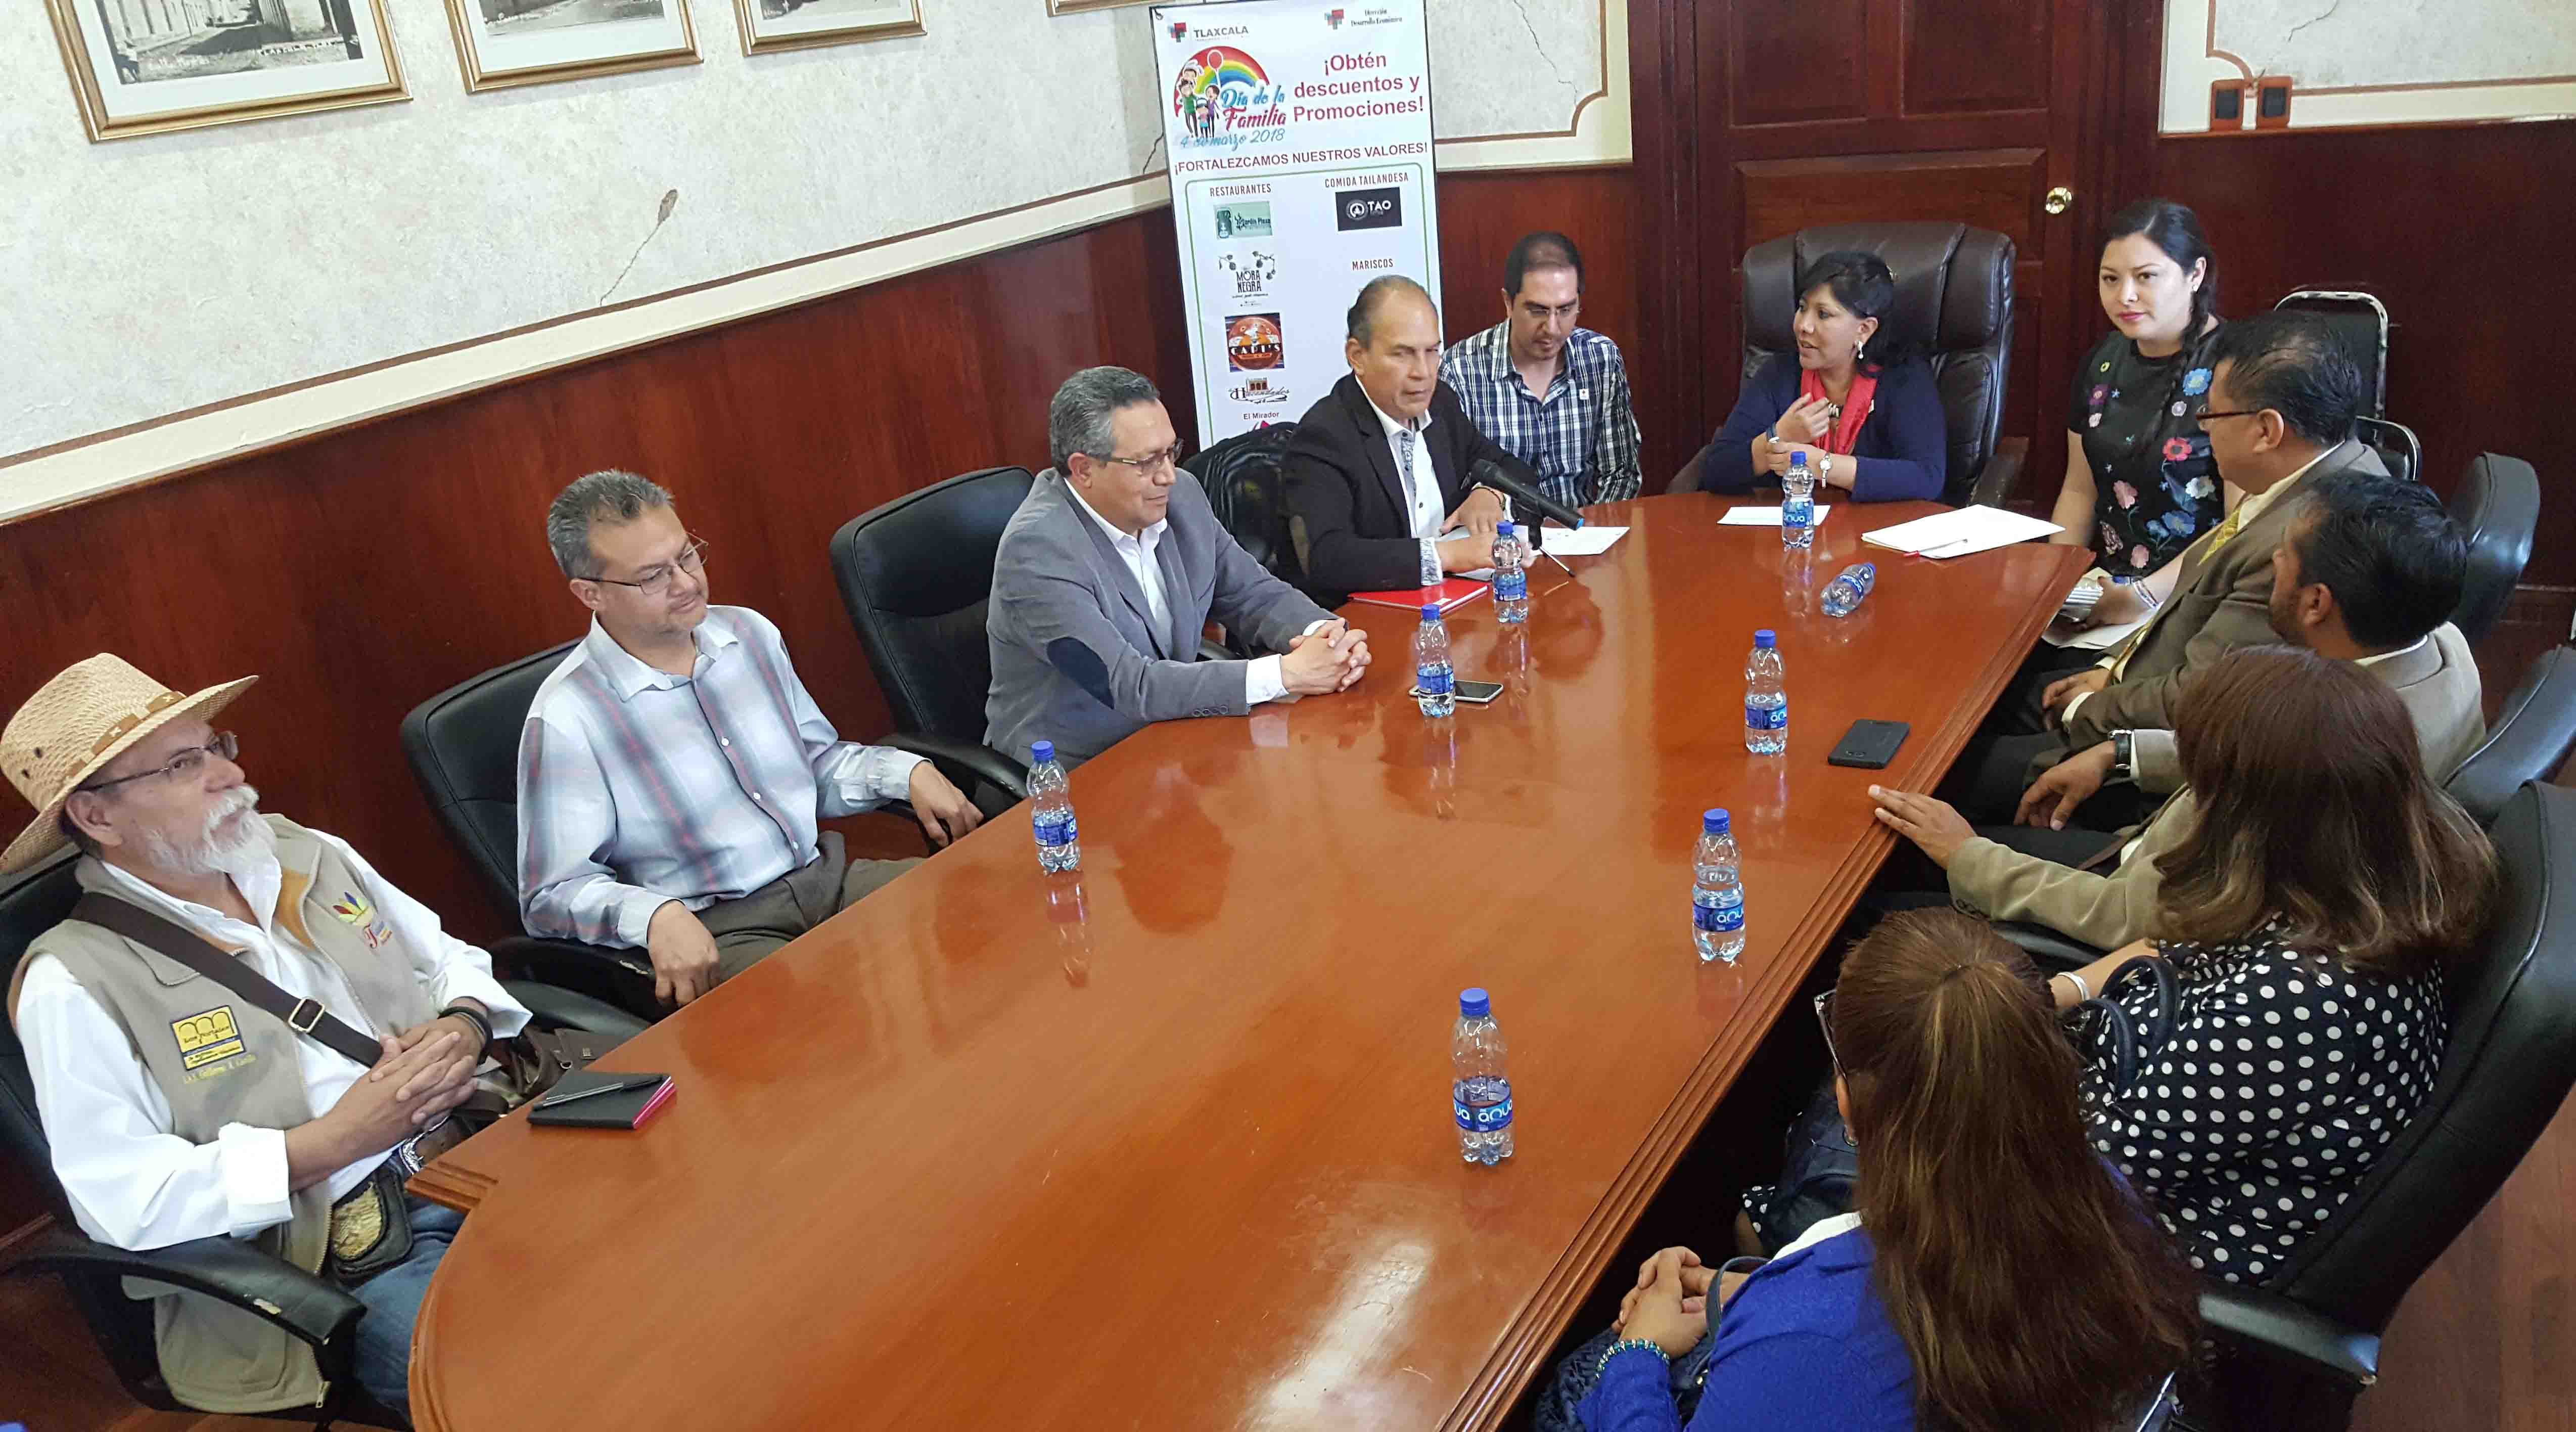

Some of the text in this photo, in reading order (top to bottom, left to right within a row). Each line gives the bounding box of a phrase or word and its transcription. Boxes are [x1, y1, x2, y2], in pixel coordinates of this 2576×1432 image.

[1193, 25, 1249, 38] TLAXCALA
[1324, 52, 1387, 76] ¡Obtén
[1253, 86, 1269, 105] de
[1273, 84, 1285, 105] la
[1294, 75, 1420, 98] descuentos y
[1294, 95, 1423, 122] Promociones!
[1223, 104, 1286, 131] Familia
[1250, 128, 1285, 144] 2018
[1175, 142, 1428, 175] ¡FORTALEZCAMOS NUESTROS VALORES!
[1325, 172, 1408, 188] COMIDA TAILANDESA
[1210, 183, 1272, 197] RESTAURANTES
[1367, 200, 1392, 211] TAO
[1352, 258, 1394, 271] MARISCOS
[1236, 270, 1261, 281] MORA
[1237, 281, 1262, 293] NEGRA
[1253, 411, 1279, 419] Mirador
